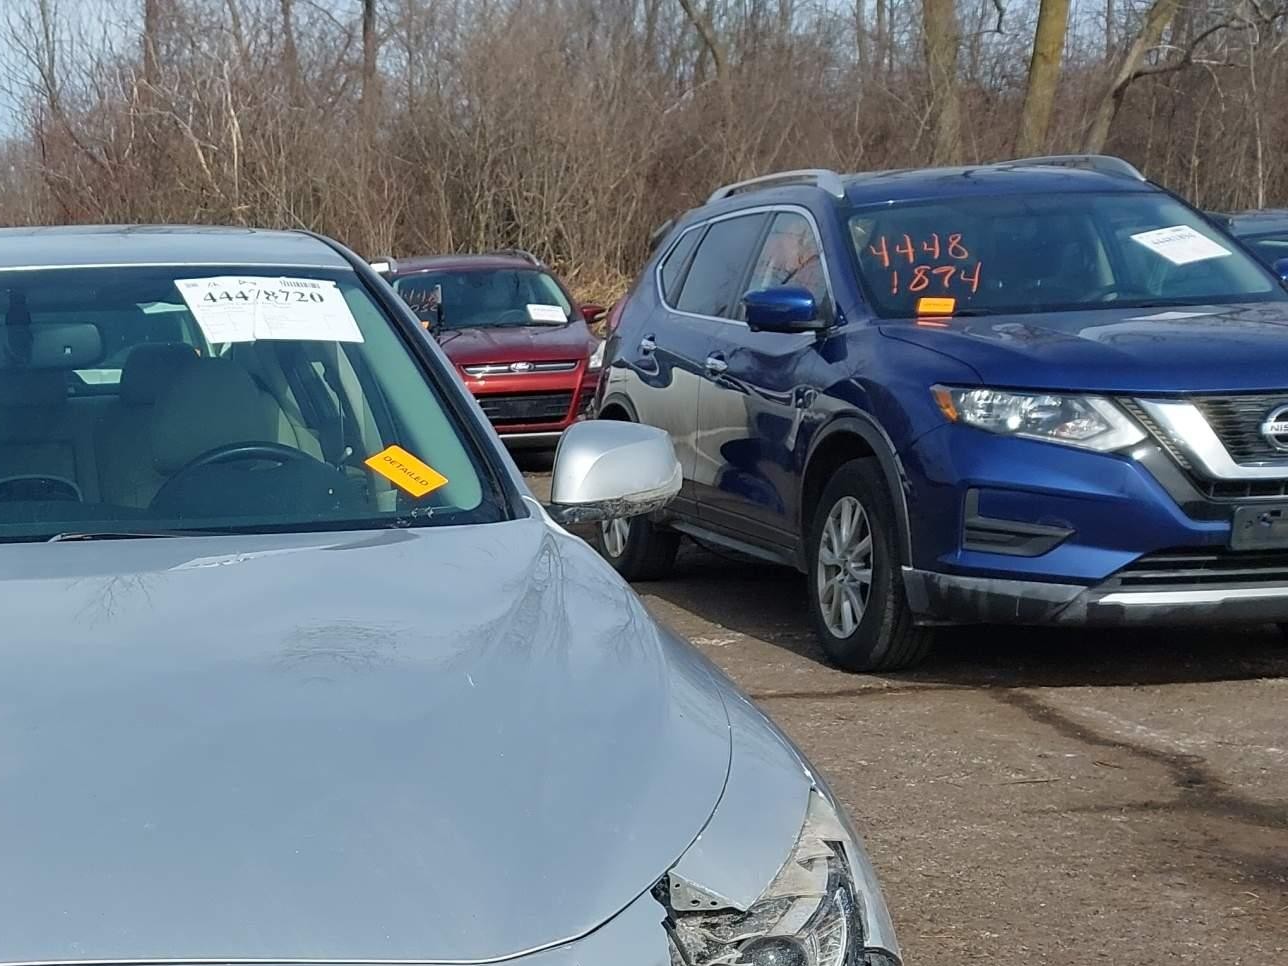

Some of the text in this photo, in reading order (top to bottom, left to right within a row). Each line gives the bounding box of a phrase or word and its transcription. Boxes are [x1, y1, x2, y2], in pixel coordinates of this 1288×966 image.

[869, 233, 969, 267] 4448
[892, 261, 982, 294] 1874
[203, 288, 325, 303] 44478720
[383, 455, 429, 486] DETAILED
